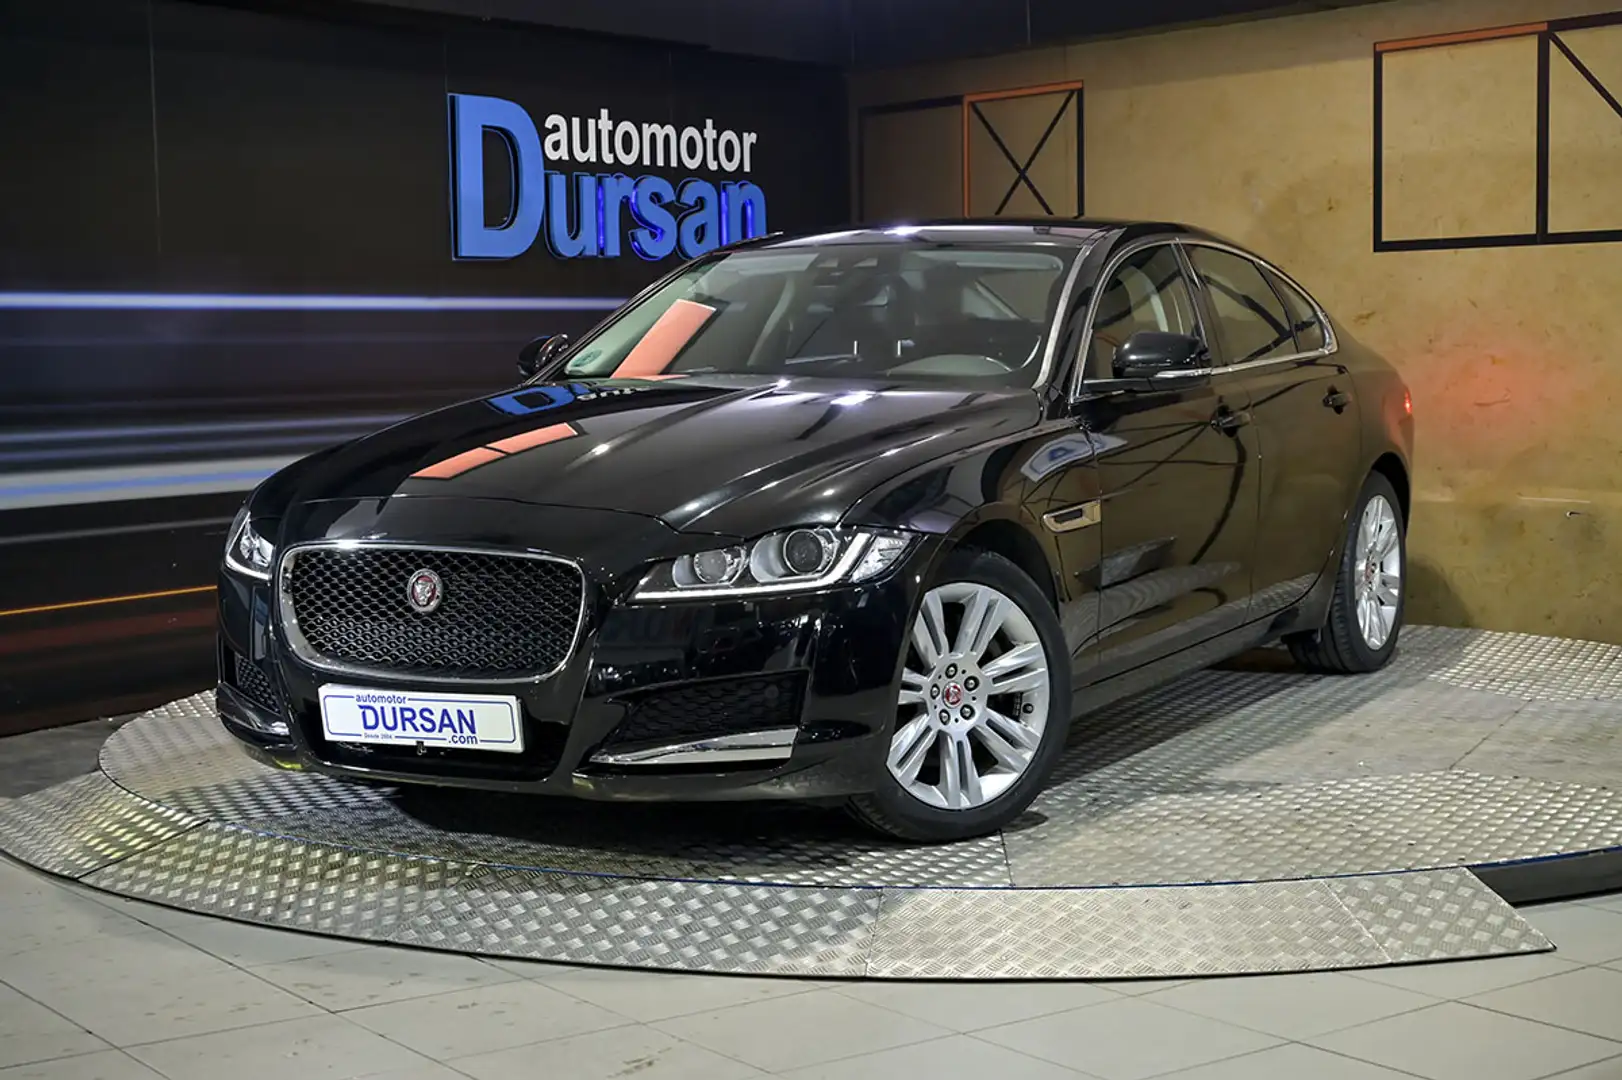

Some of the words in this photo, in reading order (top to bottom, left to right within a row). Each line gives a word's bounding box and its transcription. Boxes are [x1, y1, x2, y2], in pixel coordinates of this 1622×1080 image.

[544, 108, 757, 172] automotor
[447, 93, 767, 261] Dursan
[355, 694, 407, 704] automotor
[358, 704, 477, 735] DURSAN
[448, 734, 478, 745] .com
